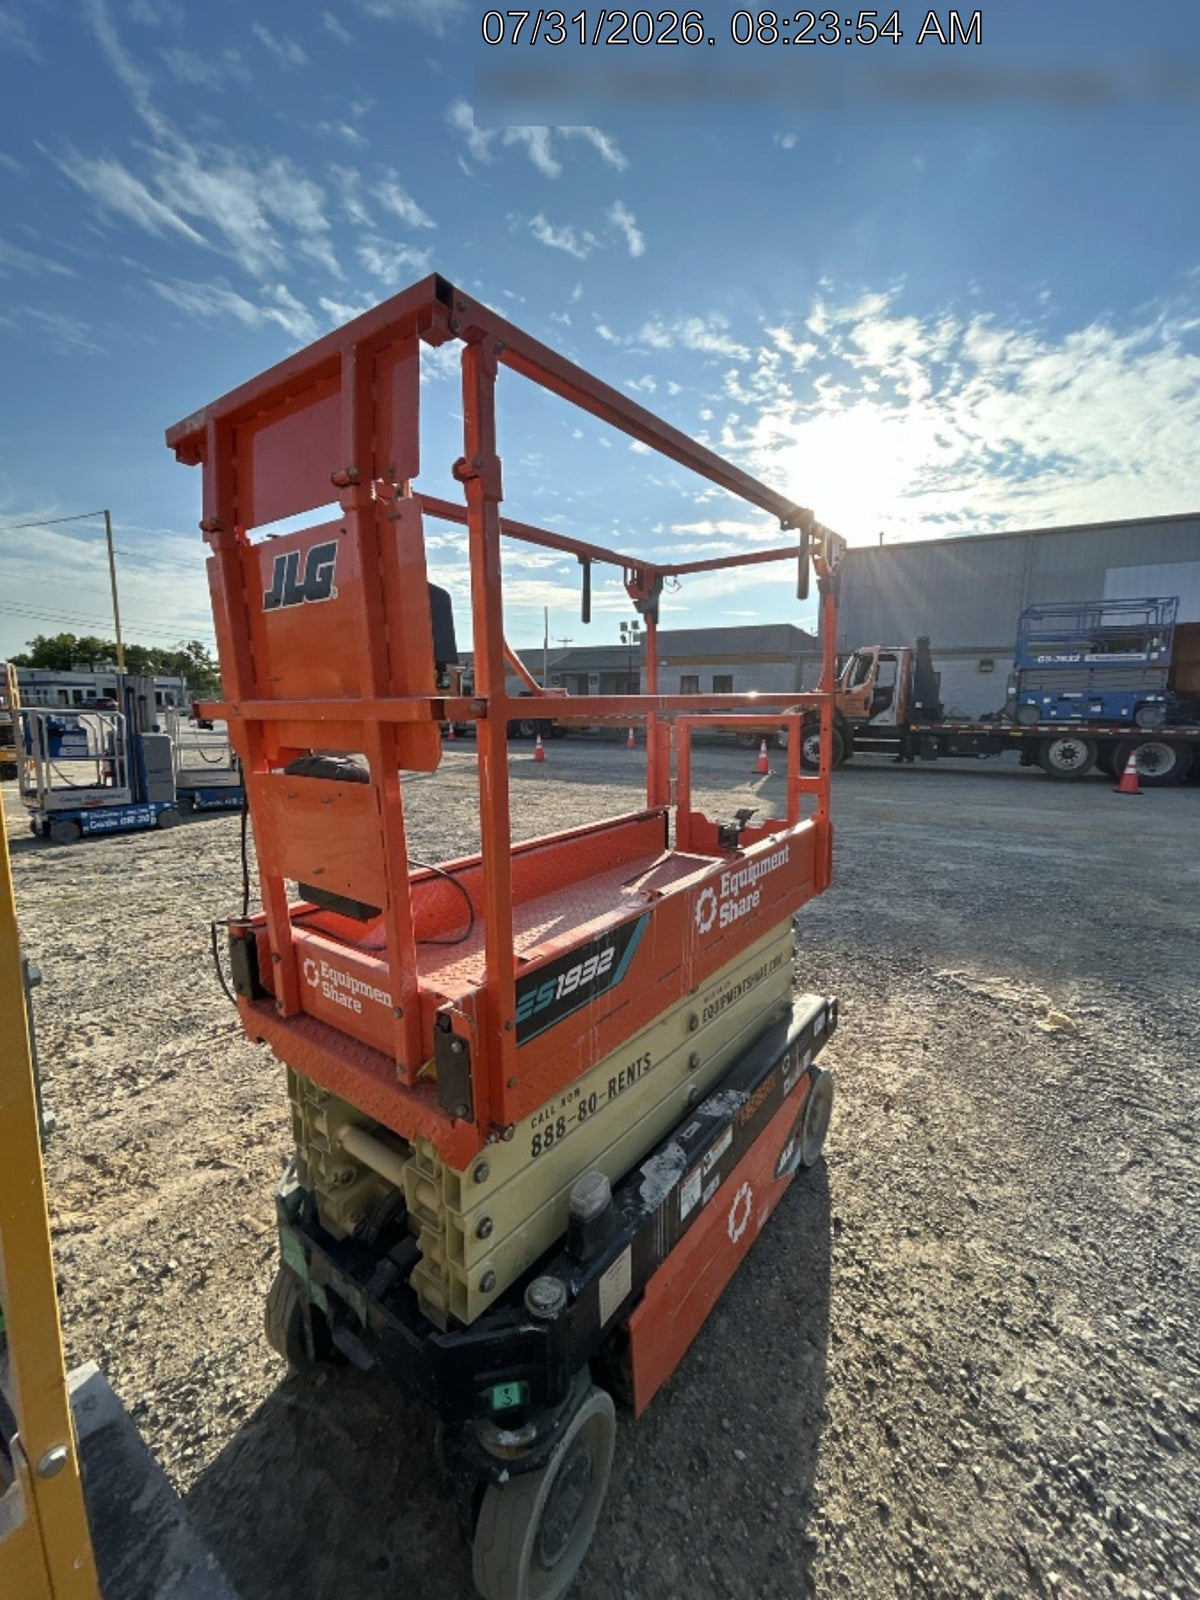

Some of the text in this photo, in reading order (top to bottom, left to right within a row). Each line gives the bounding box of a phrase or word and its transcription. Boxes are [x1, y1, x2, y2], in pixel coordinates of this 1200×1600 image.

[262, 539, 339, 612] JLG
[720, 844, 790, 898] Equipment
[719, 889, 761, 929] Share
[320, 960, 394, 1009] Equipmen
[321, 980, 362, 1014] Share
[516, 947, 615, 1023] ES1932
[531, 1052, 652, 1158] 888-80-RENTS
[531, 1107, 557, 1129] CALL
